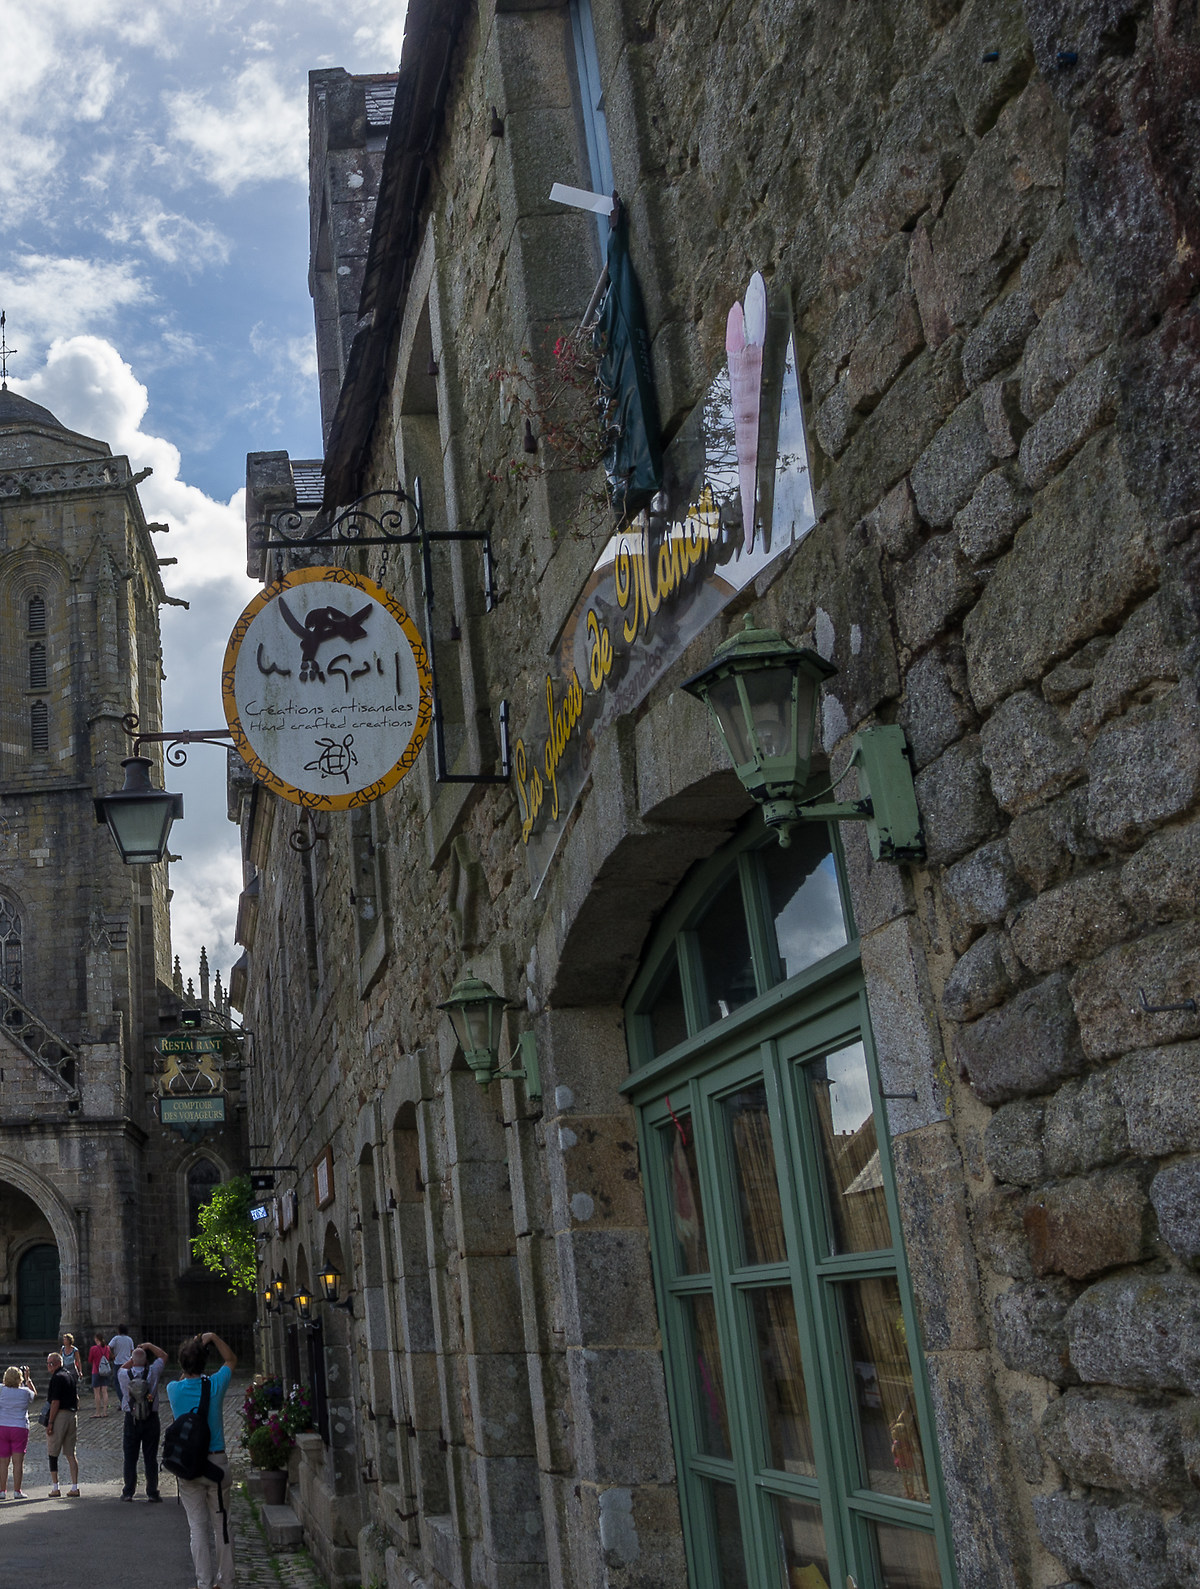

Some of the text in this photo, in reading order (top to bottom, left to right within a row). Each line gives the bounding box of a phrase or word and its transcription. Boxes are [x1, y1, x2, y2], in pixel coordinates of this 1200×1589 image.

[516, 738, 543, 845] Les
[544, 668, 584, 821] glaces
[586, 608, 614, 692] de
[615, 483, 721, 645] Manon
[330, 696, 413, 714] artisanales
[250, 715, 413, 731] Hand crafted creations
[173, 1101, 212, 1110] COMPTOIR
[164, 1110, 223, 1121] DES VOYAGEURS
